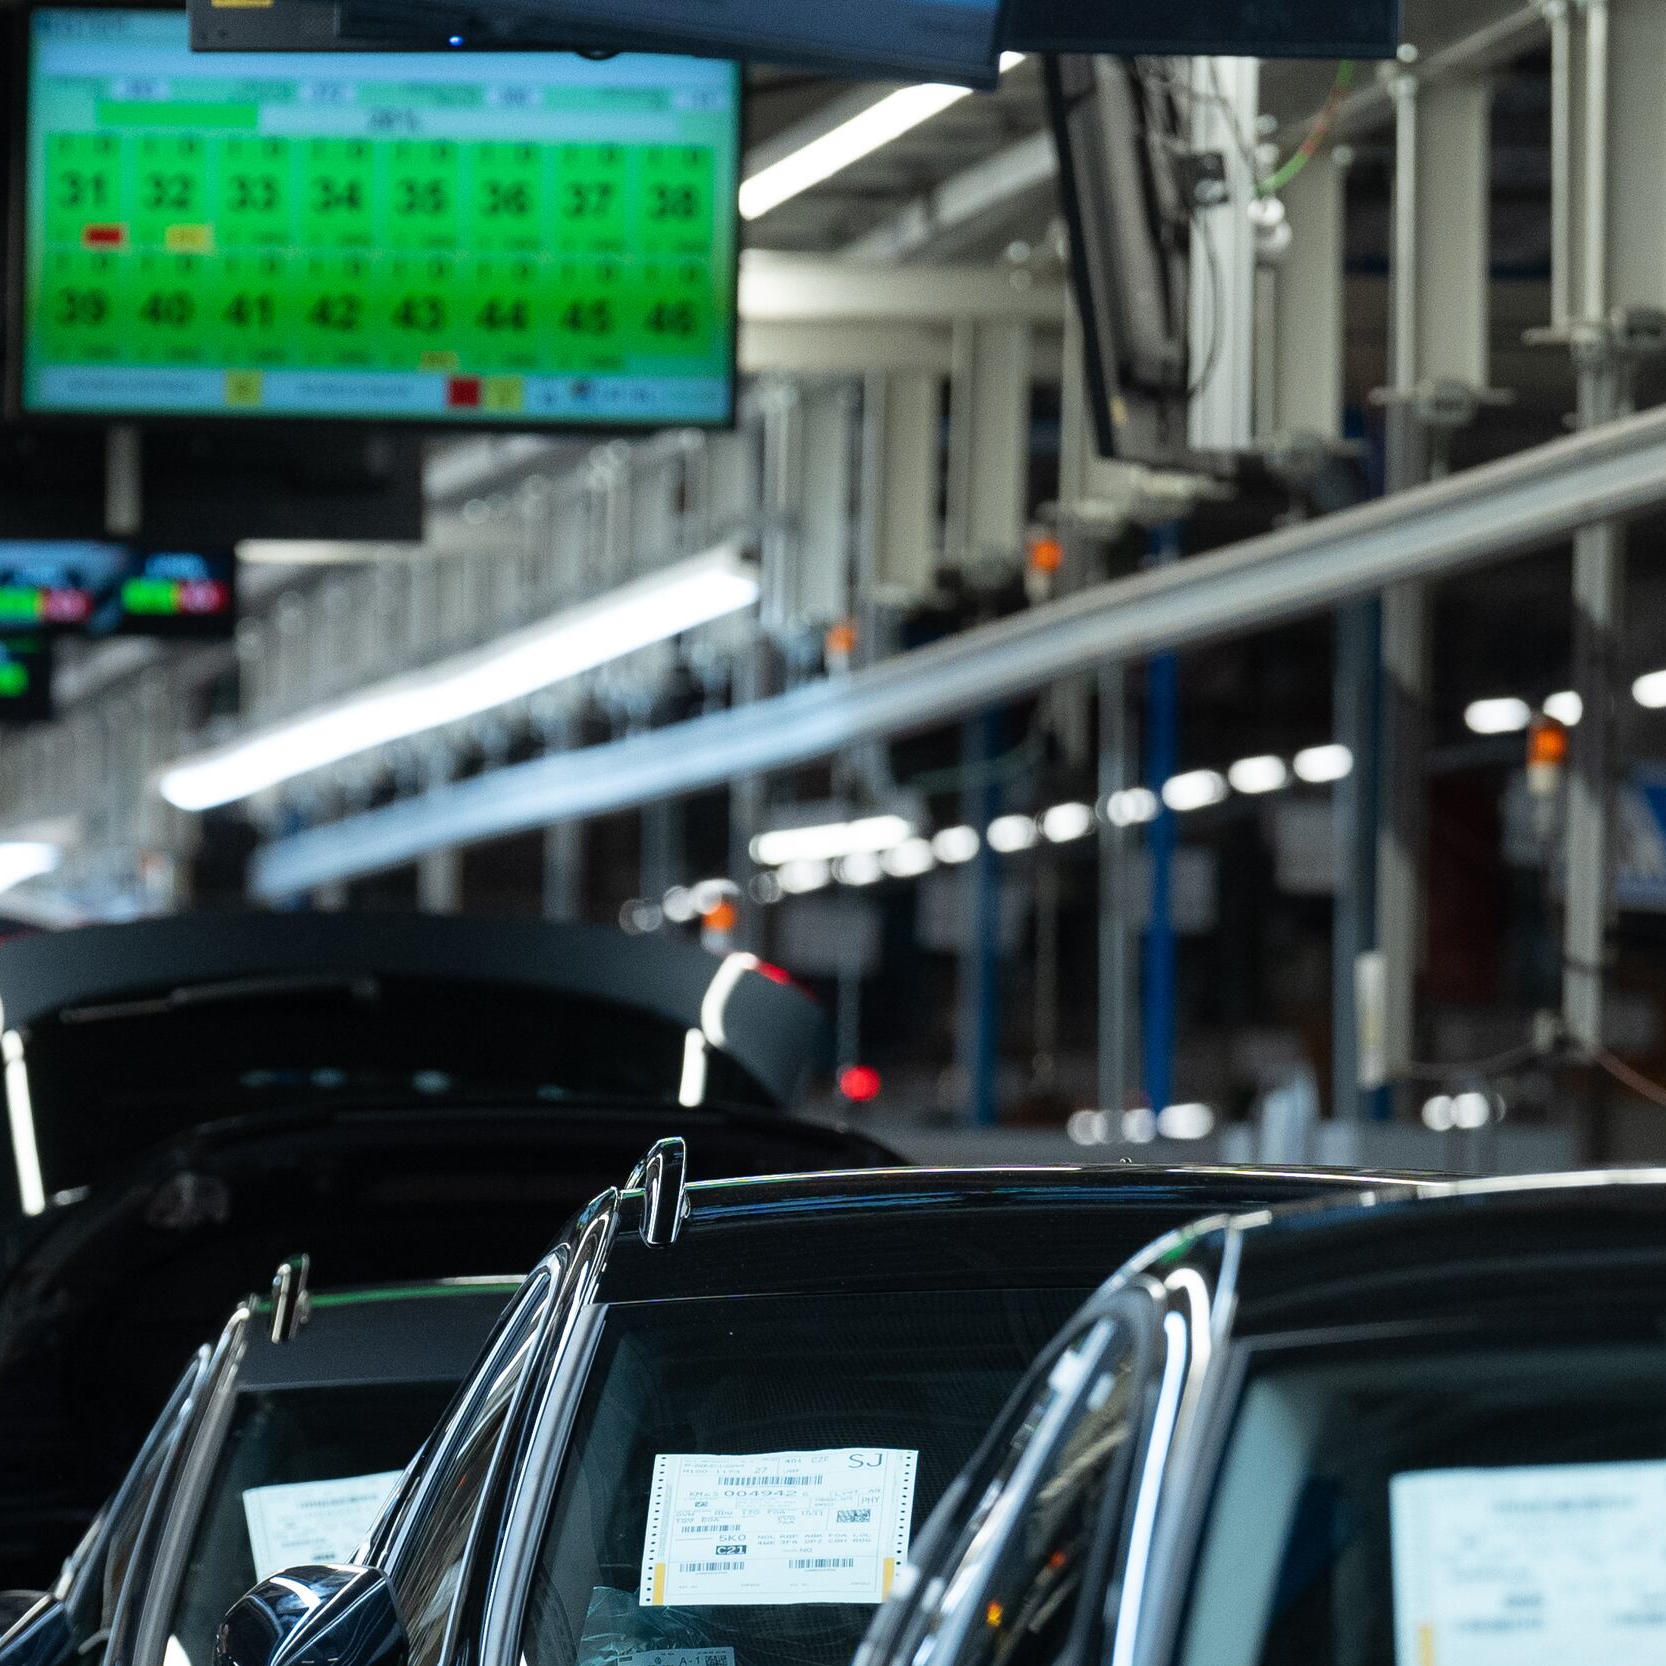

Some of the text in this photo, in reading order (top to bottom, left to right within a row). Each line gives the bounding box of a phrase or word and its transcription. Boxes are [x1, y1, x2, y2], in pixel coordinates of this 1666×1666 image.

[59, 171, 699, 221] 31 32 33 34 35 36 37 38
[57, 290, 699, 338] 39 40 41 42 43 44 45 46
[848, 1453, 883, 1469] SJ
[724, 1489, 797, 1497] 004942
[716, 1545, 747, 1555] C21
